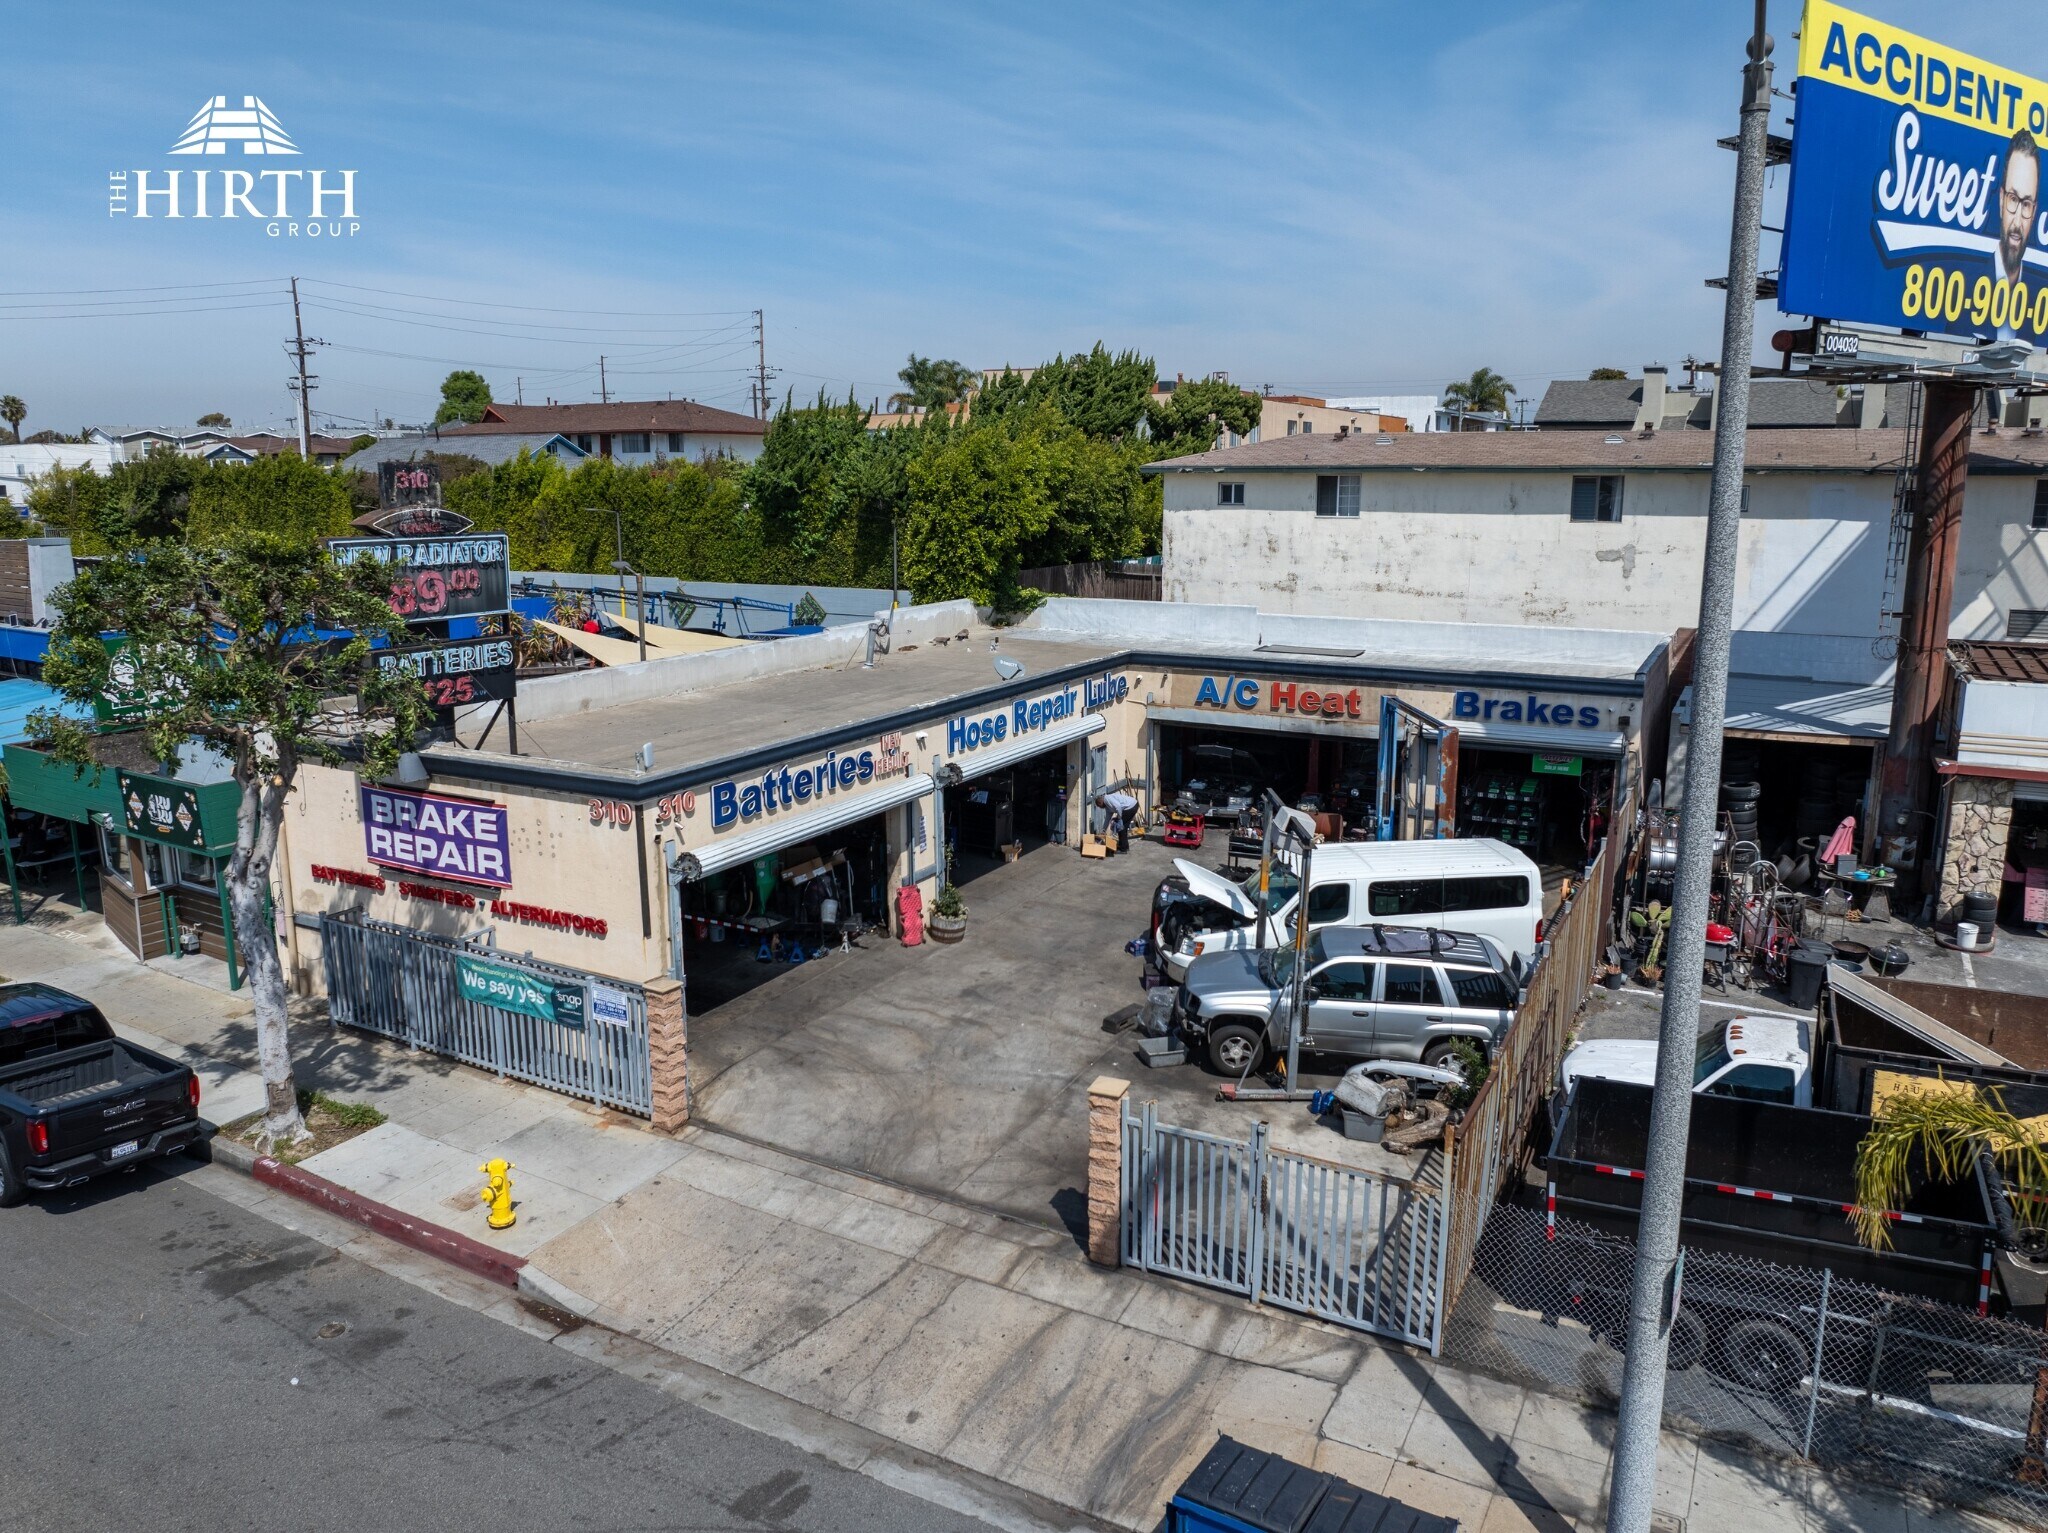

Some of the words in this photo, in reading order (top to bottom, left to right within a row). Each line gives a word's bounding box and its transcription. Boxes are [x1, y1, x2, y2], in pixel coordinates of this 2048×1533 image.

[1820, 21, 2023, 130] ACCIDENT
[1878, 111, 1998, 230] Sweet
[1826, 335, 1859, 354] 004032
[395, 469, 429, 489] 310
[397, 540, 504, 568] RADIATOR
[379, 640, 514, 682] BATTERIES
[423, 675, 475, 706] $25
[1195, 675, 1260, 707] A/C
[1270, 681, 1362, 716] Heat
[1454, 690, 1601, 728] Brakes
[947, 714, 1008, 756] Hose
[1012, 683, 1078, 735] Repair
[1083, 671, 1129, 710] Lube
[880, 731, 902, 752] NEW
[875, 751, 910, 776] REBUILT
[658, 790, 697, 821] 310
[711, 750, 874, 829] Batteries
[370, 794, 499, 843] BRAKE
[588, 798, 633, 825] 310
[370, 826, 505, 878] REPAIR
[311, 863, 387, 892] BATTERIES
[399, 881, 477, 909] STARTERS
[490, 899, 609, 936] ALTERNATORS
[463, 968, 487, 990] We
[489, 980, 516, 1000] say
[518, 986, 546, 1005] yes
[557, 993, 583, 1008] snap
[103, 1098, 147, 1118] GMC
